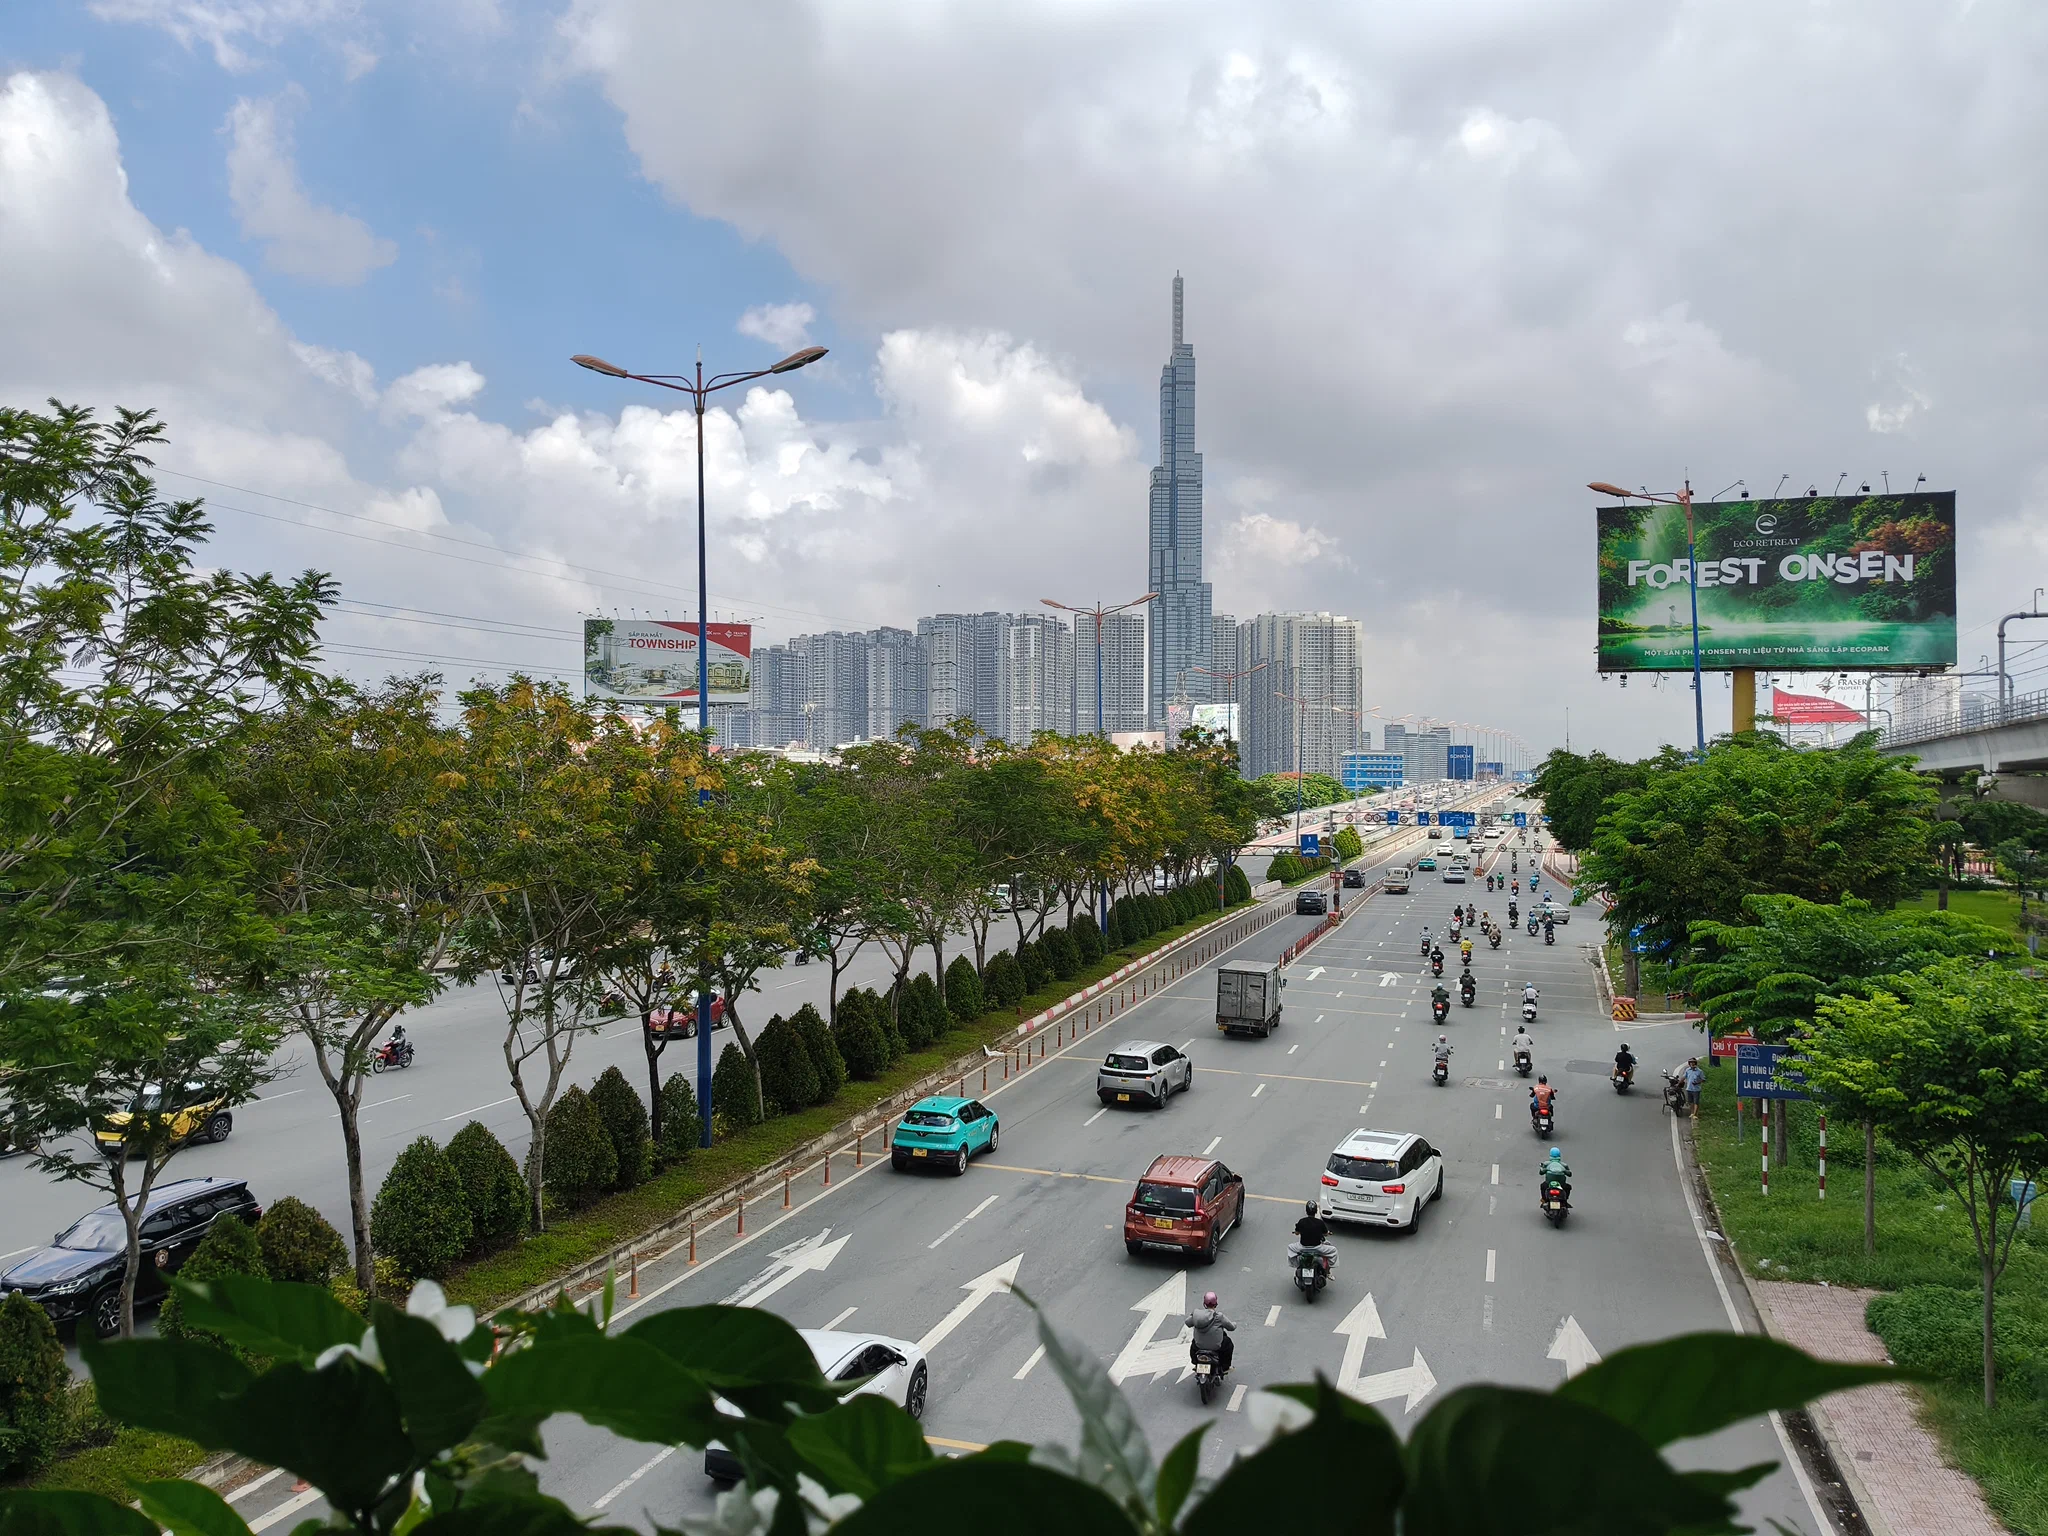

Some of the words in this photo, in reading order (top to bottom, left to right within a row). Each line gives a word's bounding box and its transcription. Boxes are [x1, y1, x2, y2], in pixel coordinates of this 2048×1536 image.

[1733, 540, 1754, 548] ECO
[1755, 538, 1800, 547] RETREAT
[1627, 557, 1766, 590] FOREST
[1779, 550, 1914, 584] ONSEN
[628, 638, 697, 649] TOWNSHIP
[1644, 649, 1662, 657] MỘT
[1837, 678, 1867, 686] FRASER
[1742, 1065, 1749, 1074] ĐI
